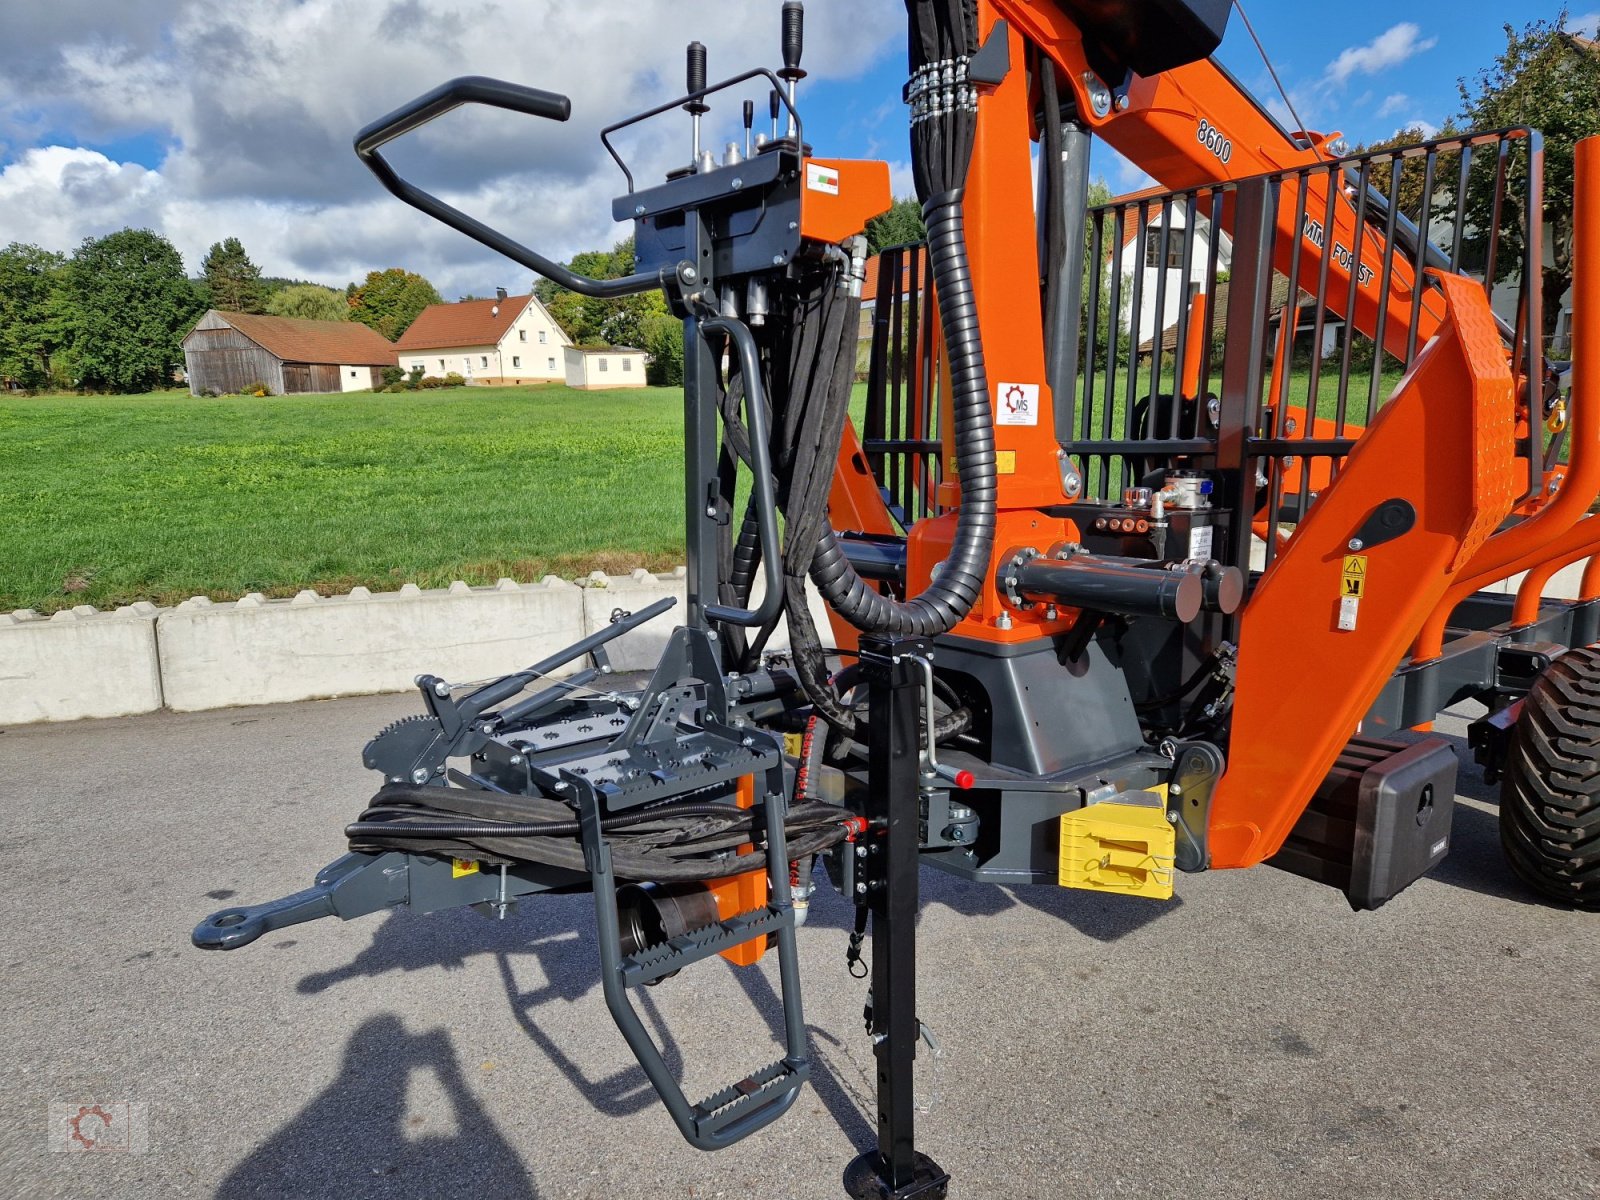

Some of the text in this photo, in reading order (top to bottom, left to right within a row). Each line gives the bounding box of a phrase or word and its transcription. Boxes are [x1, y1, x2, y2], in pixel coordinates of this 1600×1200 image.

[1197, 118, 1231, 164] 8600
[1331, 241, 1375, 288] FORST
[1016, 399, 1028, 412] MS
